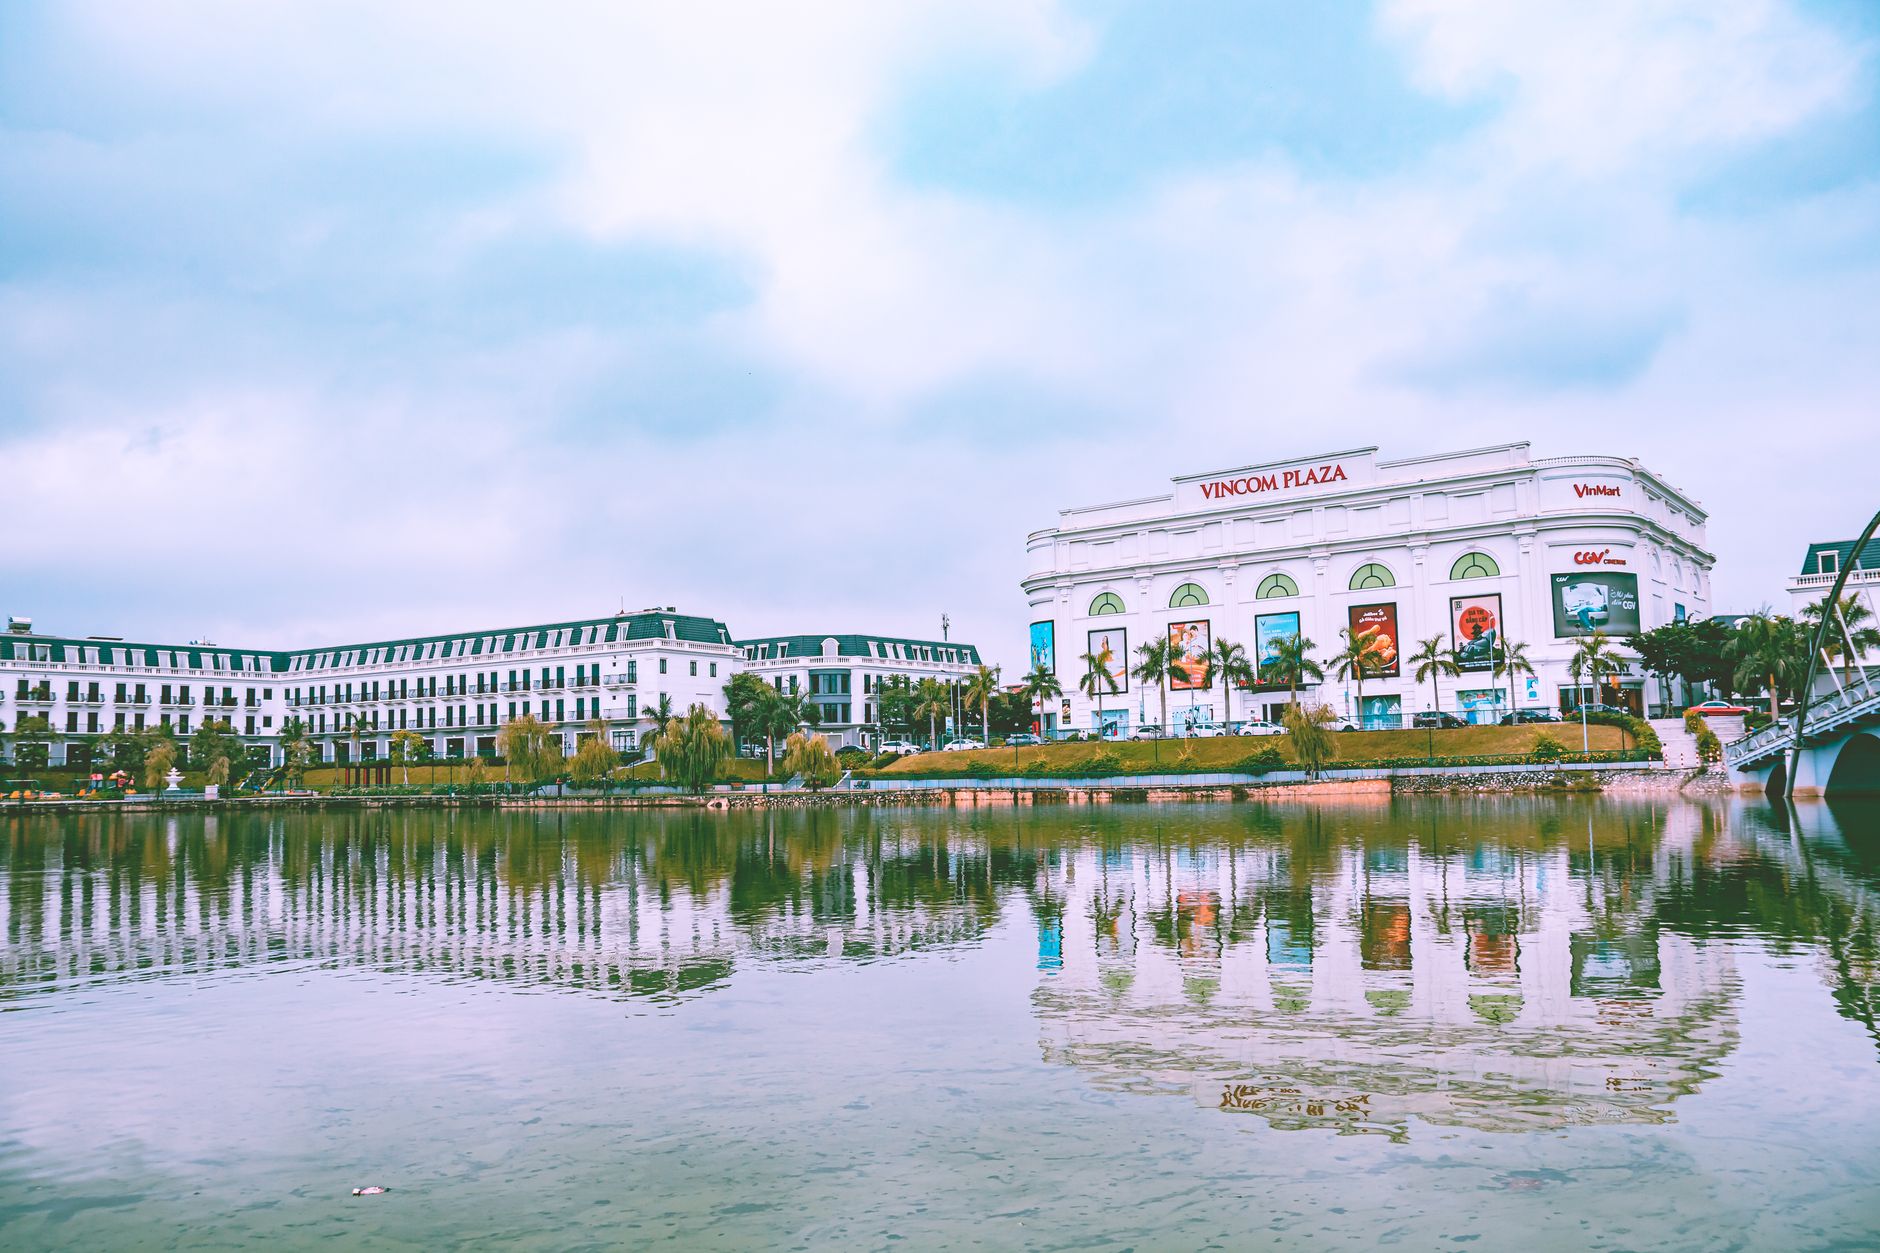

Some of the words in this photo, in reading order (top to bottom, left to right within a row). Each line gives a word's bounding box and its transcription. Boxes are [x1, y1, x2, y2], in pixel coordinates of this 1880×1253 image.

[1200, 474, 1279, 500] VINCOM
[1282, 464, 1348, 489] PLAZA
[1573, 551, 1605, 565] CGV
[1622, 600, 1636, 610] CGV
